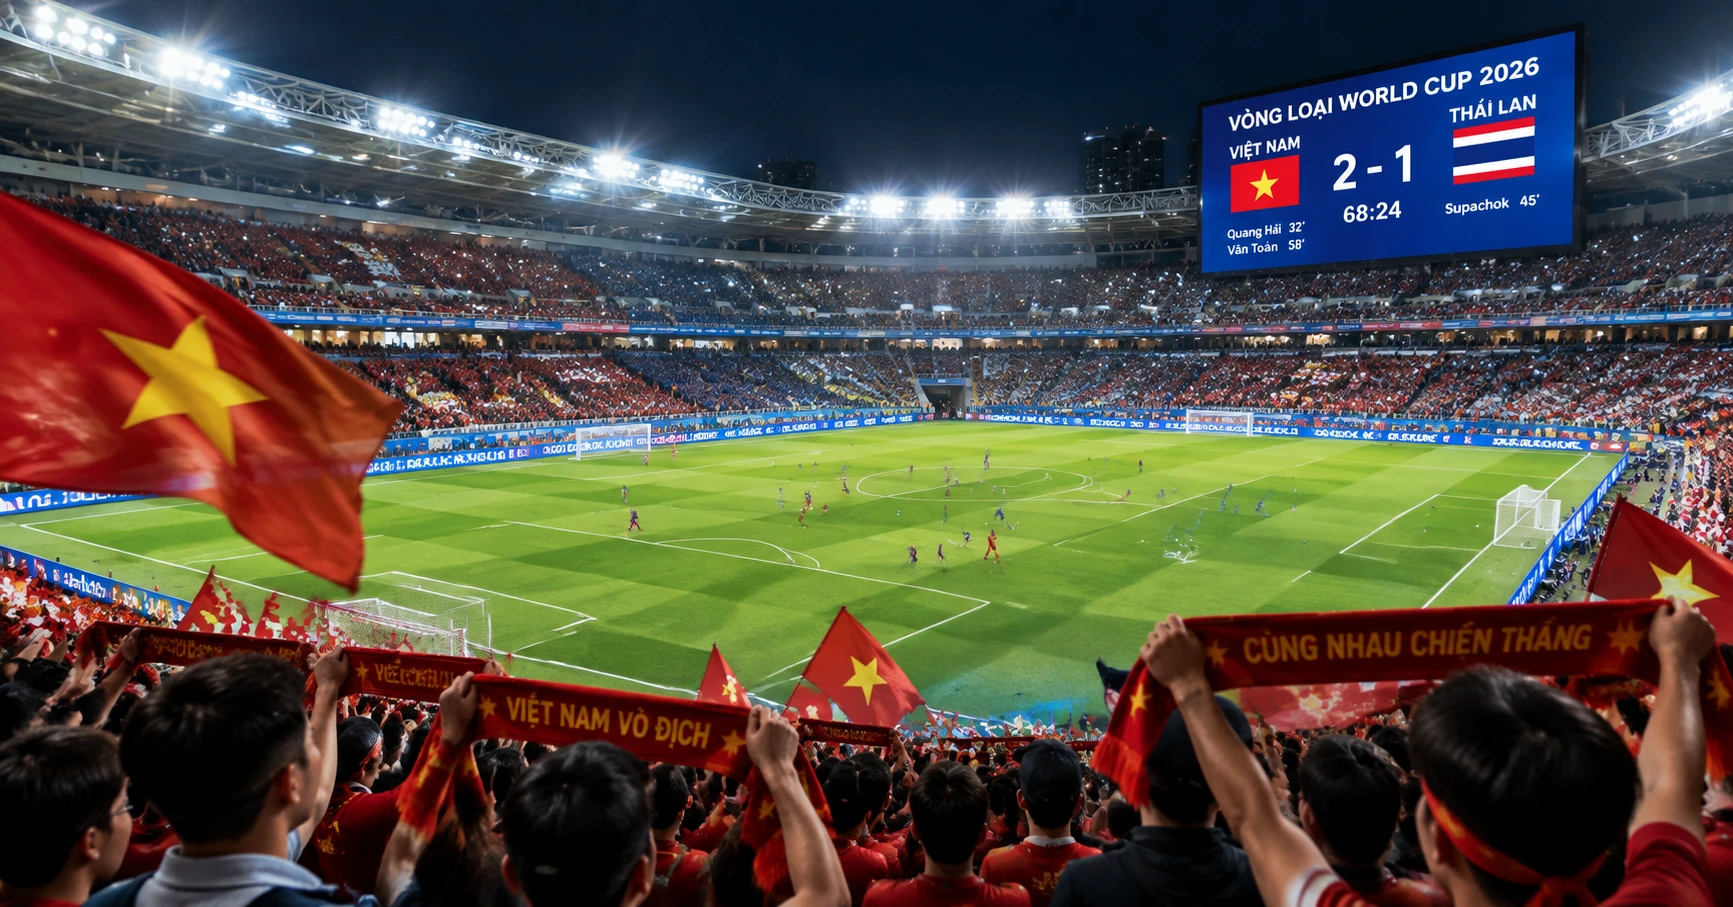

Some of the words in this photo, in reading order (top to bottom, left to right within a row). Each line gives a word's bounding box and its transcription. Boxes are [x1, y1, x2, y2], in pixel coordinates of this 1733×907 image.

[1228, 107, 1283, 132] VÒNG
[1288, 97, 1333, 121] LOẠI
[1338, 81, 1418, 111] WORLD
[1424, 70, 1473, 96] CUP
[1479, 56, 1540, 86] 2026
[1498, 93, 1537, 115] LAN
[1229, 140, 1262, 161] VIỆT
[1266, 135, 1301, 154] NAM
[1333, 153, 1357, 191] 2
[1395, 144, 1411, 182] 1
[1343, 200, 1402, 223] 68:24
[1444, 197, 1510, 216] Supachok
[1227, 229, 1263, 240] Quang
[1326, 631, 1402, 660] NHAU
[560, 703, 610, 733] NAM
[654, 716, 712, 750] ĐỊCH
